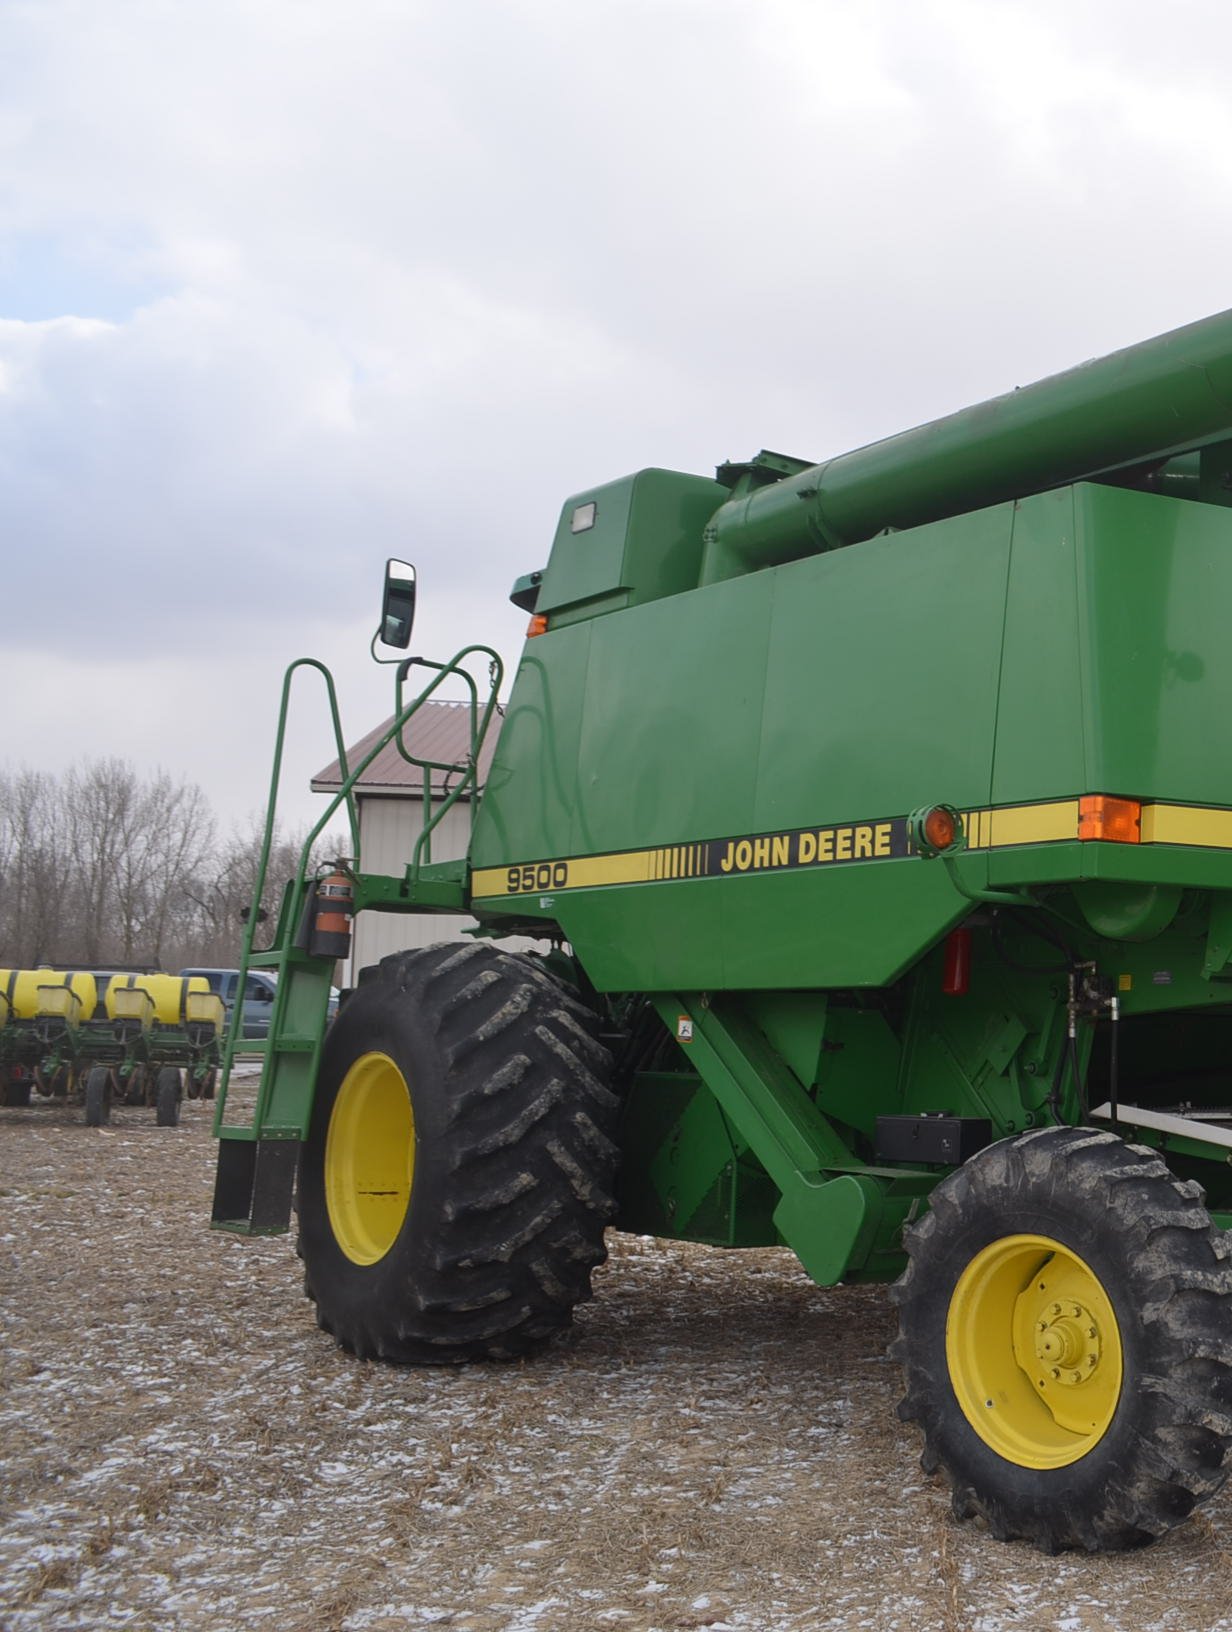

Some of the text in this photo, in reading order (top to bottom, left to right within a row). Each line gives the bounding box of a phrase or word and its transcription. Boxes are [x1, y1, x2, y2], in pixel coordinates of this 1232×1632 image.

[721, 824, 892, 872] JOHN DEERE
[507, 863, 568, 893] 9500
